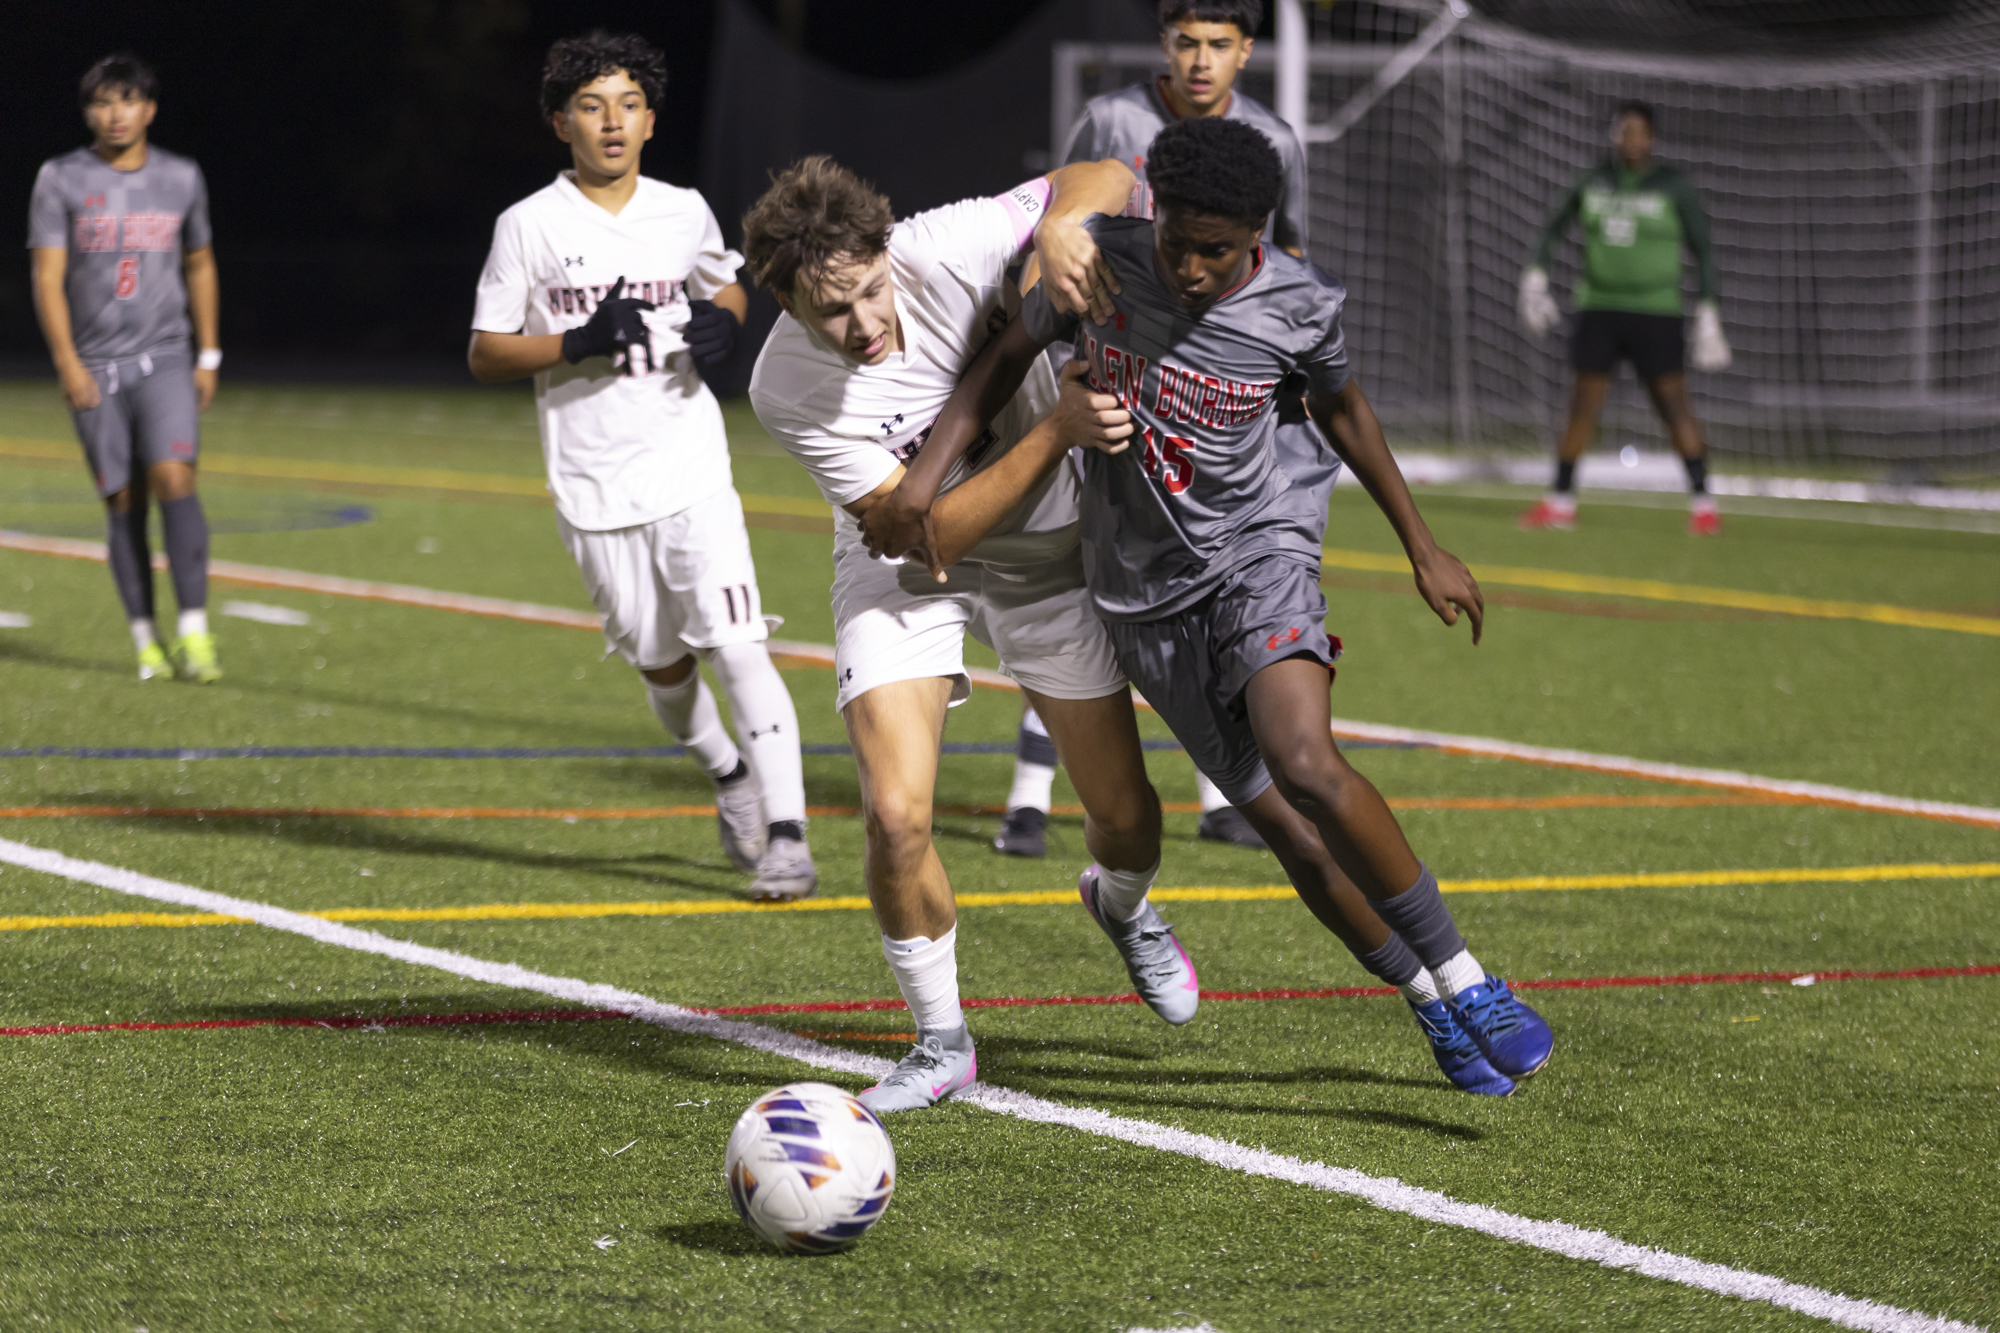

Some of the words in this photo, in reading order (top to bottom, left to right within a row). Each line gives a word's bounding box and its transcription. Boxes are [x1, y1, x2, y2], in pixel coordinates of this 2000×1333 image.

[115, 256, 139, 300] 6
[547, 284, 618, 316] NORT
[625, 279, 685, 308] COUN
[1141, 425, 1198, 496] 15
[719, 583, 751, 626] 11
